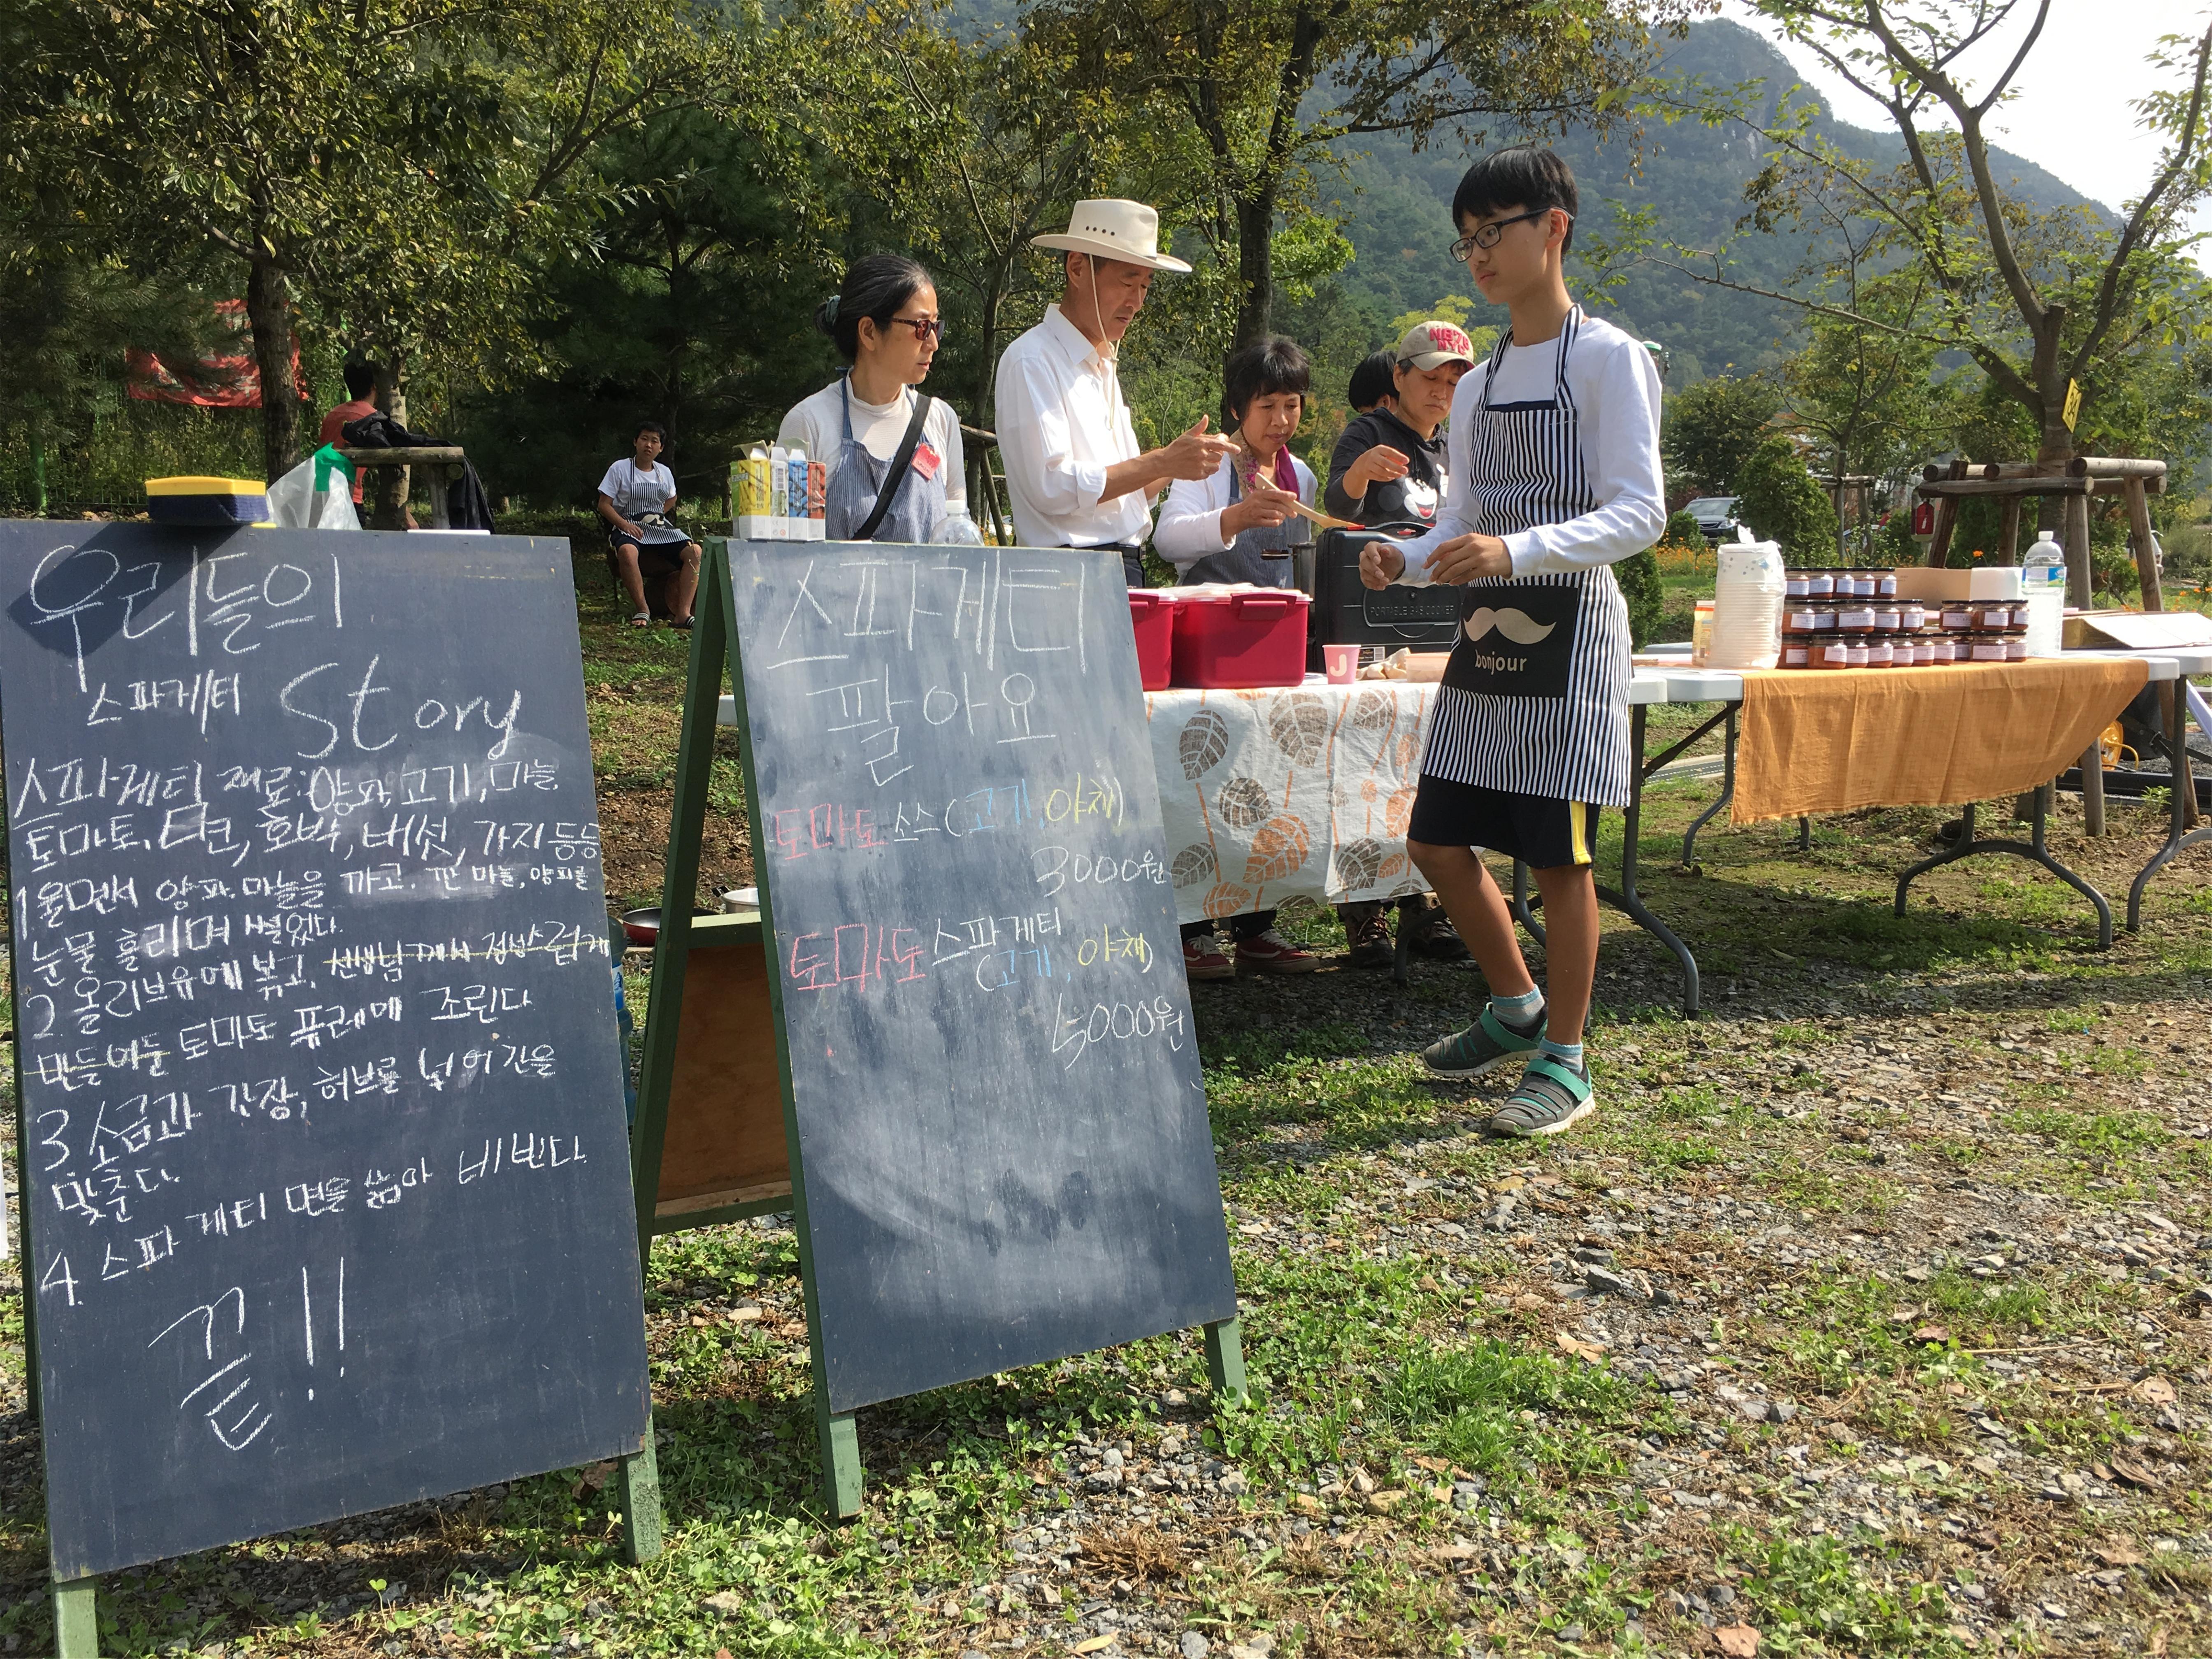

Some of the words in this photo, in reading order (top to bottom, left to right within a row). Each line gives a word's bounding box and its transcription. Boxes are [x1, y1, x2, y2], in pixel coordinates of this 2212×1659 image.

[30, 545, 342, 693] 우리들의
[767, 551, 1087, 677] 스파게티
[1329, 654, 1347, 677] J
[1475, 649, 1527, 675] bonjour
[87, 669, 240, 735] 스파게티
[280, 654, 522, 760] Story
[806, 663, 1056, 787] 팔아요
[13, 757, 202, 830] 스파게티
[1031, 846, 1167, 898] 3000원
[33, 930, 97, 987] 눈물
[932, 906, 1062, 967] 스파게티
[74, 965, 243, 1034] 올리브유에
[1052, 992, 1185, 1071] 5000원
